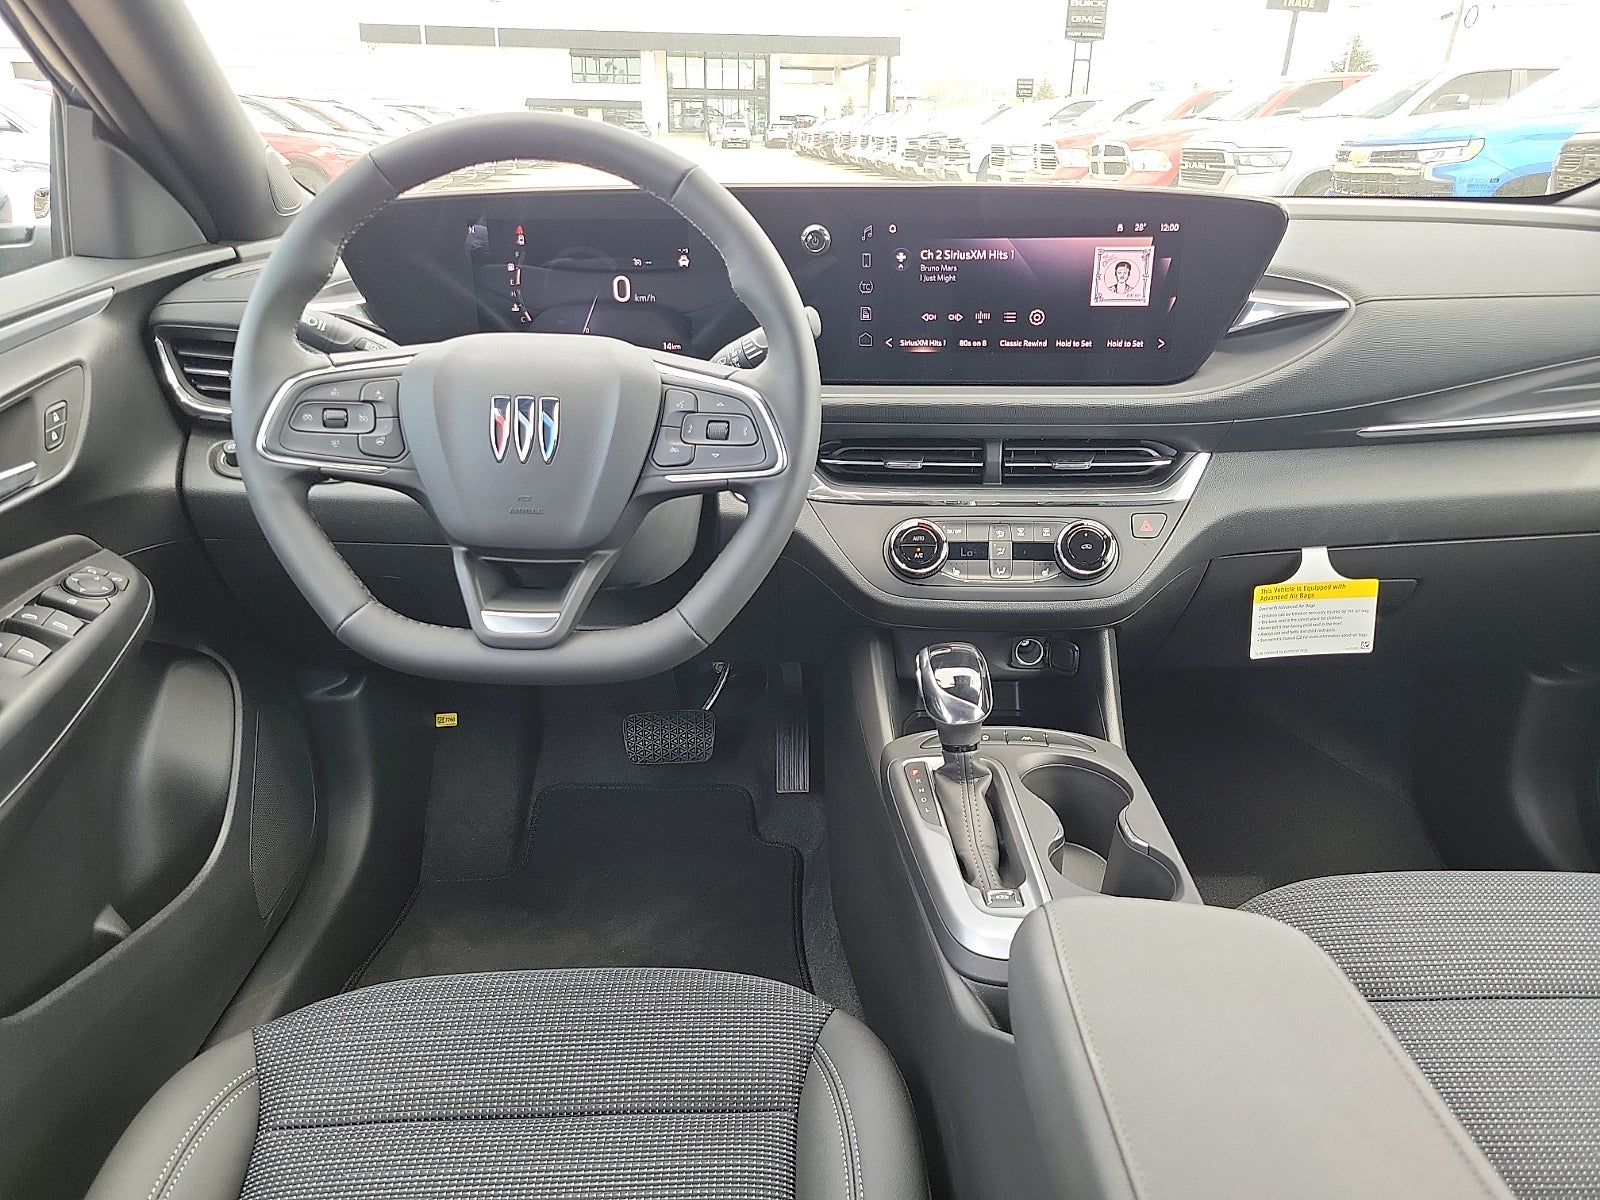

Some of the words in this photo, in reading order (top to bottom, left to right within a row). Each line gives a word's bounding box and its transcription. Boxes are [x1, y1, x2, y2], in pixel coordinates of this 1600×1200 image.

[1071, 15, 1103, 24] GMC
[1160, 222, 1180, 232] 12:00
[920, 249, 934, 260] Ch
[935, 249, 943, 260] 2
[944, 249, 987, 260] SiriusXM
[988, 249, 1009, 260] Hits
[920, 264, 940, 272] Bruno
[940, 264, 958, 272] Mars
[923, 274, 937, 283] Just
[937, 274, 957, 283] Might
[612, 274, 631, 303] 0
[634, 293, 656, 302] km/h
[899, 339, 928, 347] SiriusXM
[999, 339, 1023, 347] Classic
[1023, 339, 1048, 347] Rewind
[1055, 339, 1072, 347] Hold
[1072, 339, 1080, 347] to
[1080, 339, 1093, 347] Set
[1106, 339, 1123, 347] Hold
[1123, 339, 1131, 347] to
[1131, 339, 1145, 347] Set
[1303, 584, 1331, 592] Equipped
